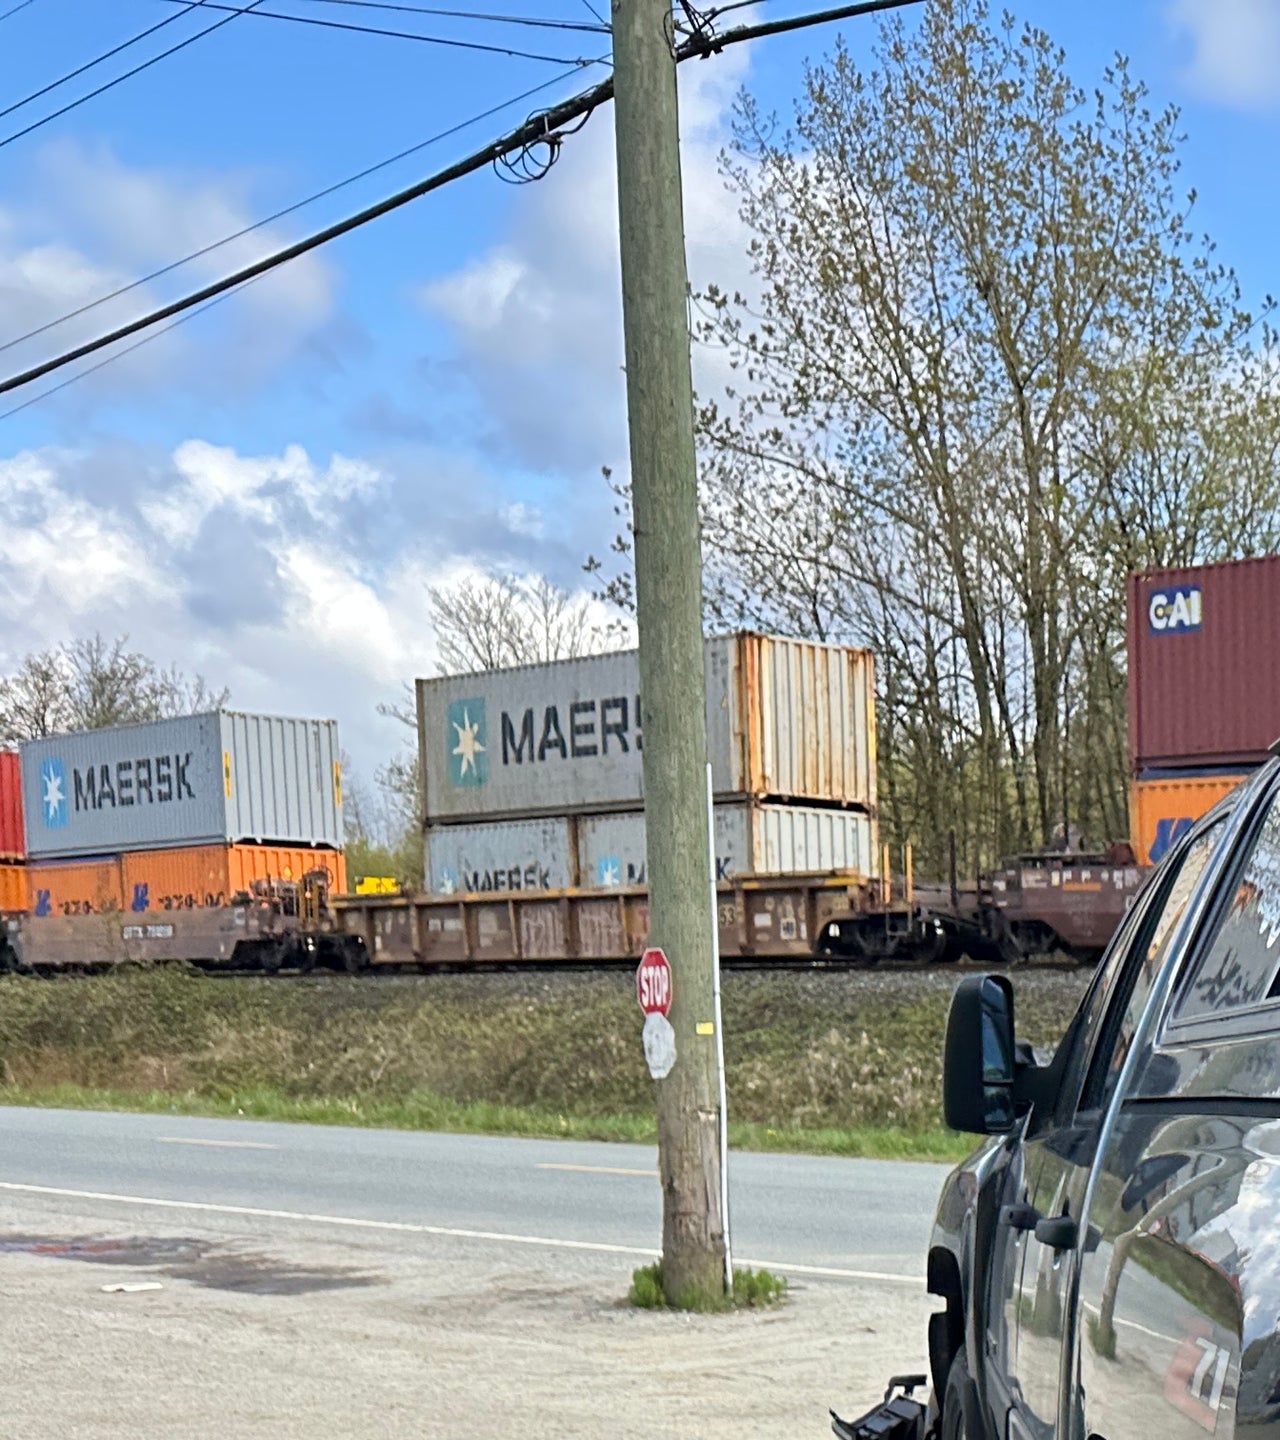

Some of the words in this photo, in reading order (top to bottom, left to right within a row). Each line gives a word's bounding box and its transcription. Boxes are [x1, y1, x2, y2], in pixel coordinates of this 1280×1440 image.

[1149, 590, 1202, 630] CAI
[501, 694, 643, 766] MAER
[73, 752, 196, 812] MAERSK
[641, 964, 669, 1008] STOP
